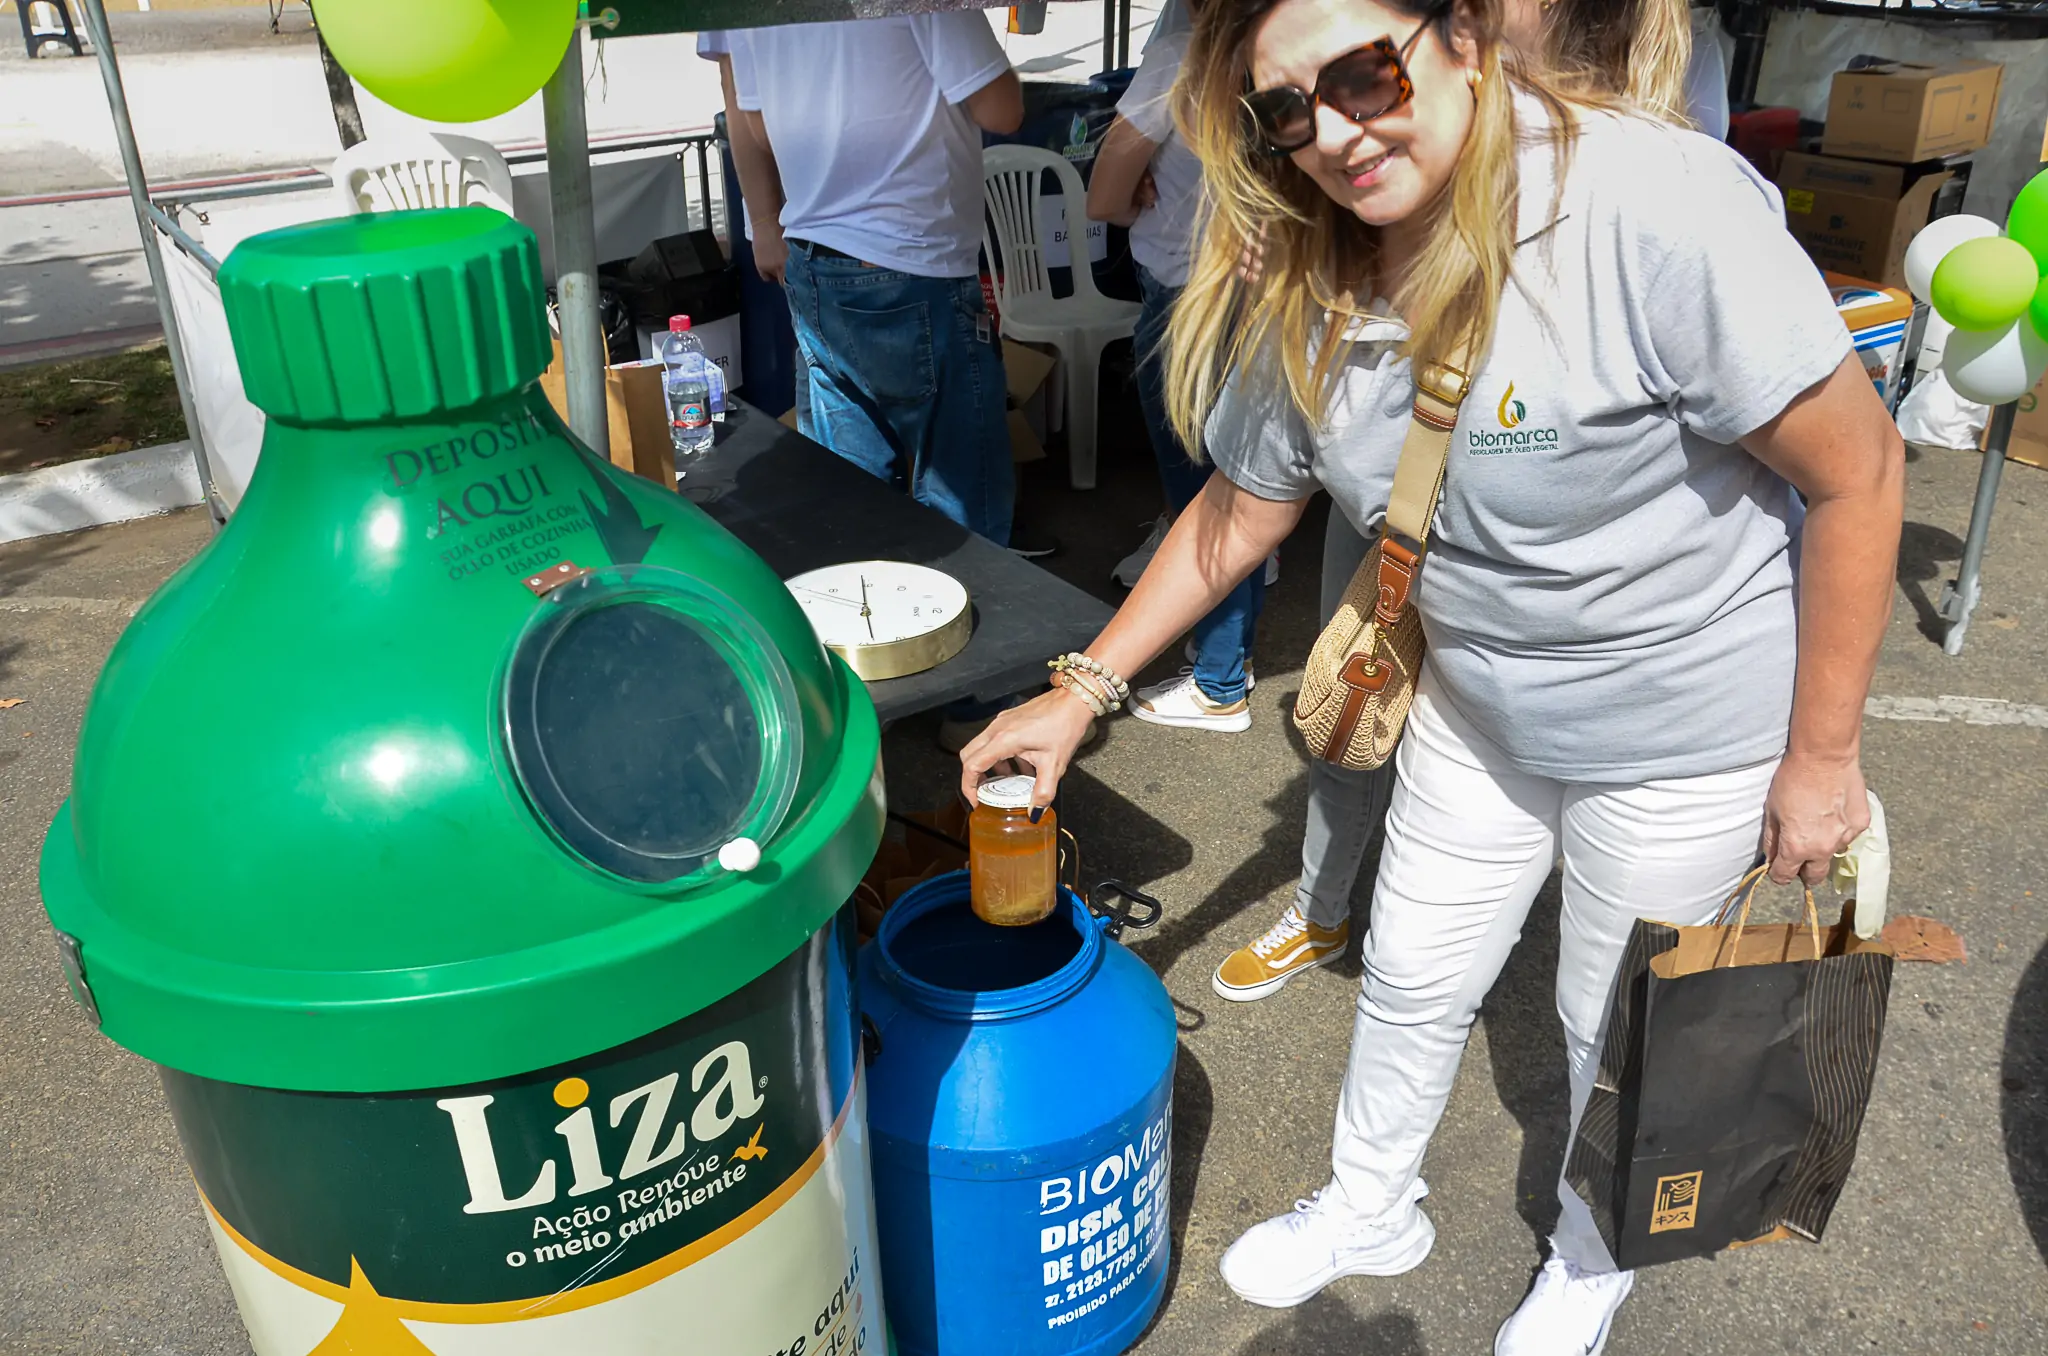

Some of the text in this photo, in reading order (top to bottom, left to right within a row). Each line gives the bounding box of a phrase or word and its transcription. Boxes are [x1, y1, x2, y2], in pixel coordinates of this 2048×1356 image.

[1469, 428, 1558, 447] biomarca
[1532, 443, 1559, 452] VEGETAL
[433, 463, 553, 537] AQUI
[440, 542, 475, 564] SUA
[474, 511, 547, 550] GARRAFA
[497, 540, 522, 562] DE
[521, 516, 594, 549] COZINHA
[505, 546, 561, 576] USADO
[436, 1040, 765, 1215] Liza
[505, 1163, 748, 1268] o meio ambiente
[532, 1154, 720, 1240] Ação Renove
[1040, 1196, 1123, 1254] DISK
[1655, 1211, 1691, 1226] キンス
[1043, 1253, 1074, 1287] DE
[1133, 1197, 1152, 1238] DE
[1047, 1293, 1108, 1330] PROIBIDO
[1109, 1271, 1136, 1299] PARA
